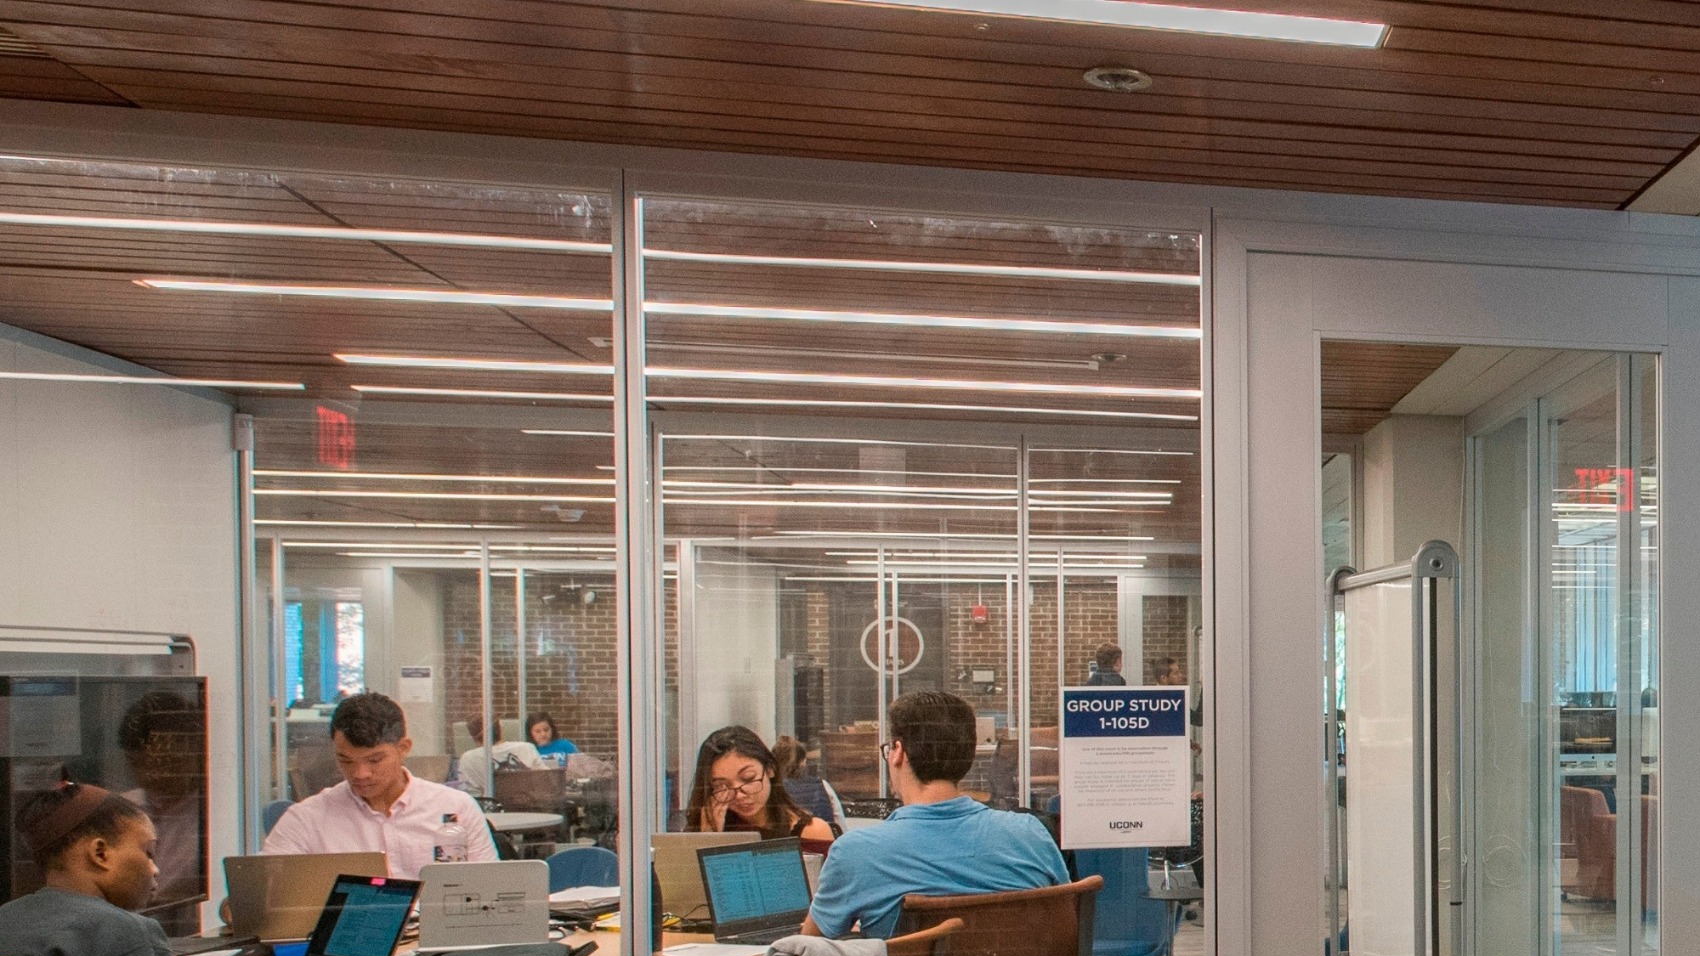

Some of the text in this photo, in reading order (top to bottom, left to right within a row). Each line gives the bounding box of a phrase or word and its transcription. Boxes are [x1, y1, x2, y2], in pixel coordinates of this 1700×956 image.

[1066, 699, 1182, 712] GROUP STUDY
[1099, 717, 1150, 729] 1-105D
[1109, 821, 1143, 829] UCONN
